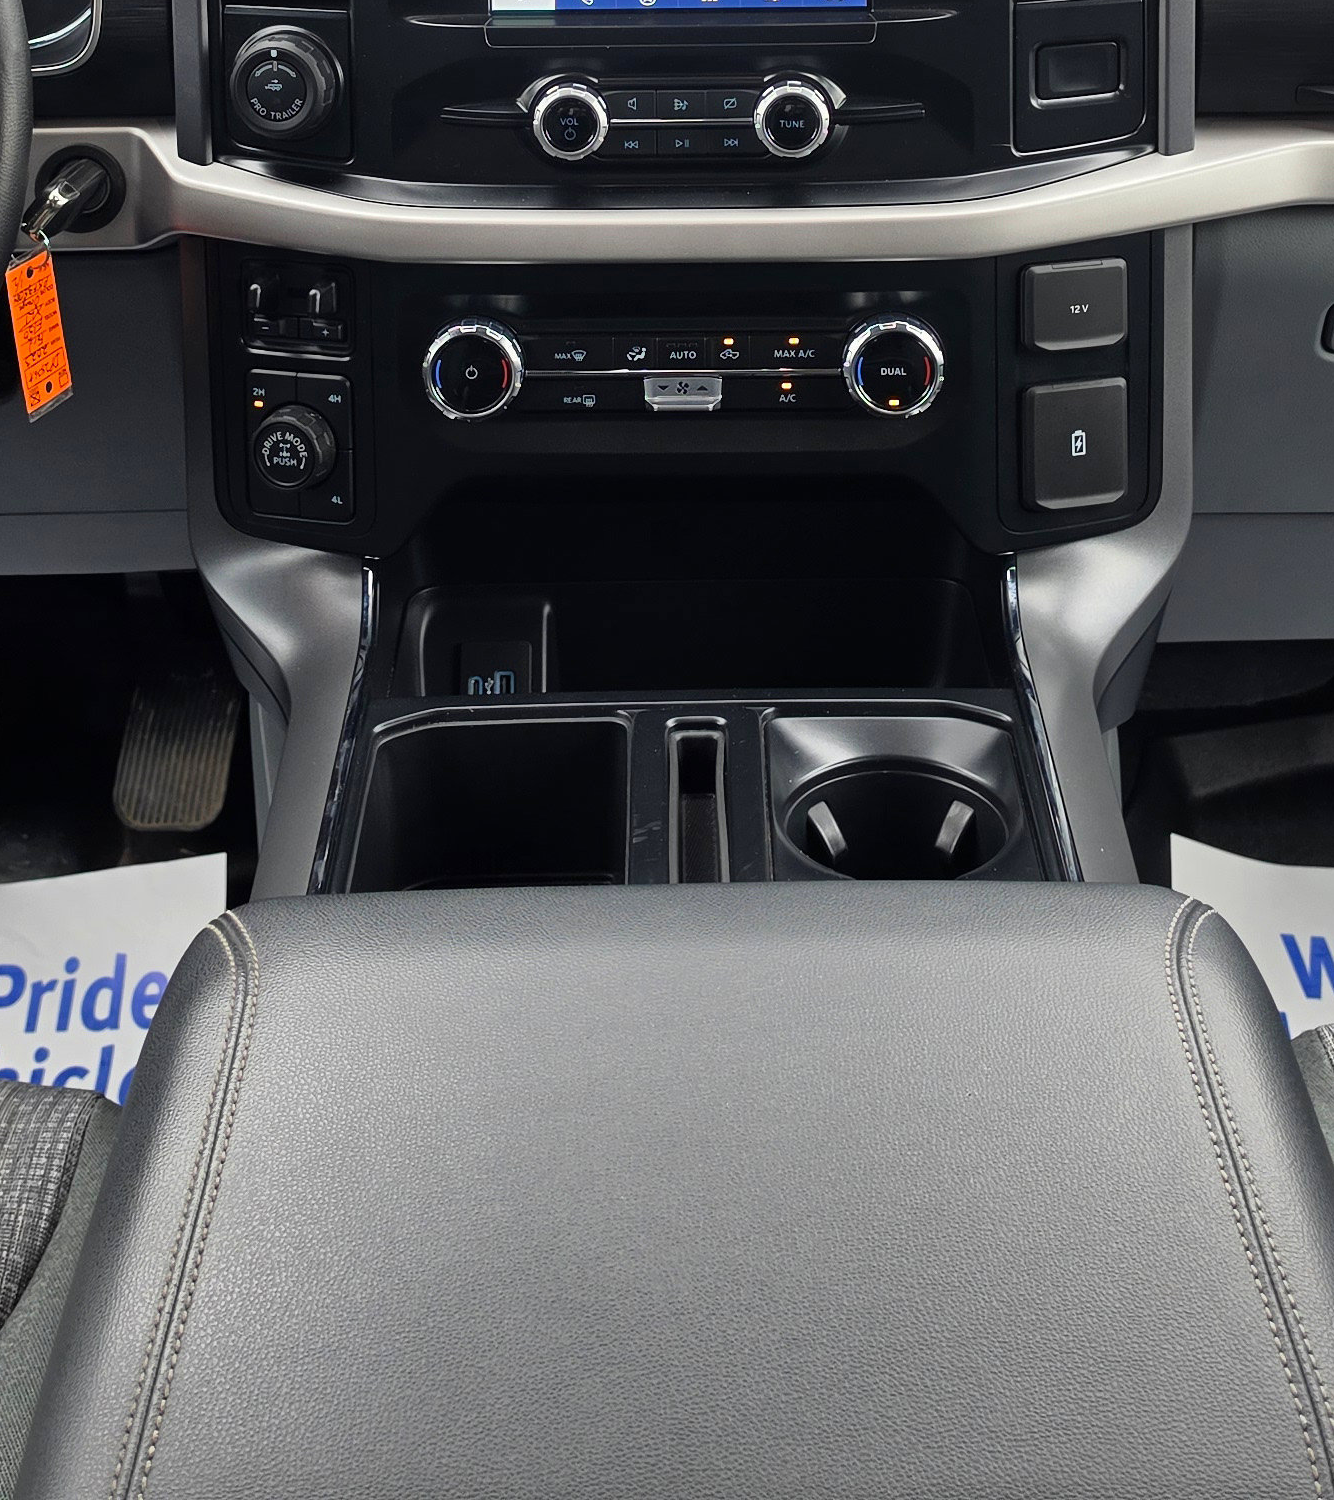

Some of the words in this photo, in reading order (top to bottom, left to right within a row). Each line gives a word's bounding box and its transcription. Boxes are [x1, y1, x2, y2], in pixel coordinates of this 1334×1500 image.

[250, 97, 267, 116] PRO
[270, 98, 304, 120] TRAILER
[560, 117, 579, 126] VOL
[779, 119, 805, 129] TUNE
[1069, 304, 1081, 314] 12
[1081, 303, 1089, 313] V
[554, 352, 572, 360] MAX
[669, 351, 697, 360] AUTO
[774, 349, 796, 359] MAX
[797, 349, 816, 359] A/C
[880, 367, 907, 376] DUAL
[252, 387, 266, 397] 2H
[328, 394, 342, 404] 4H
[563, 396, 582, 404] REAR
[779, 393, 797, 403] A/C
[262, 431, 283, 455] DRIVE
[285, 432, 308, 457] MODE
[273, 456, 298, 467] PUSH
[331, 496, 343, 505] 4L
